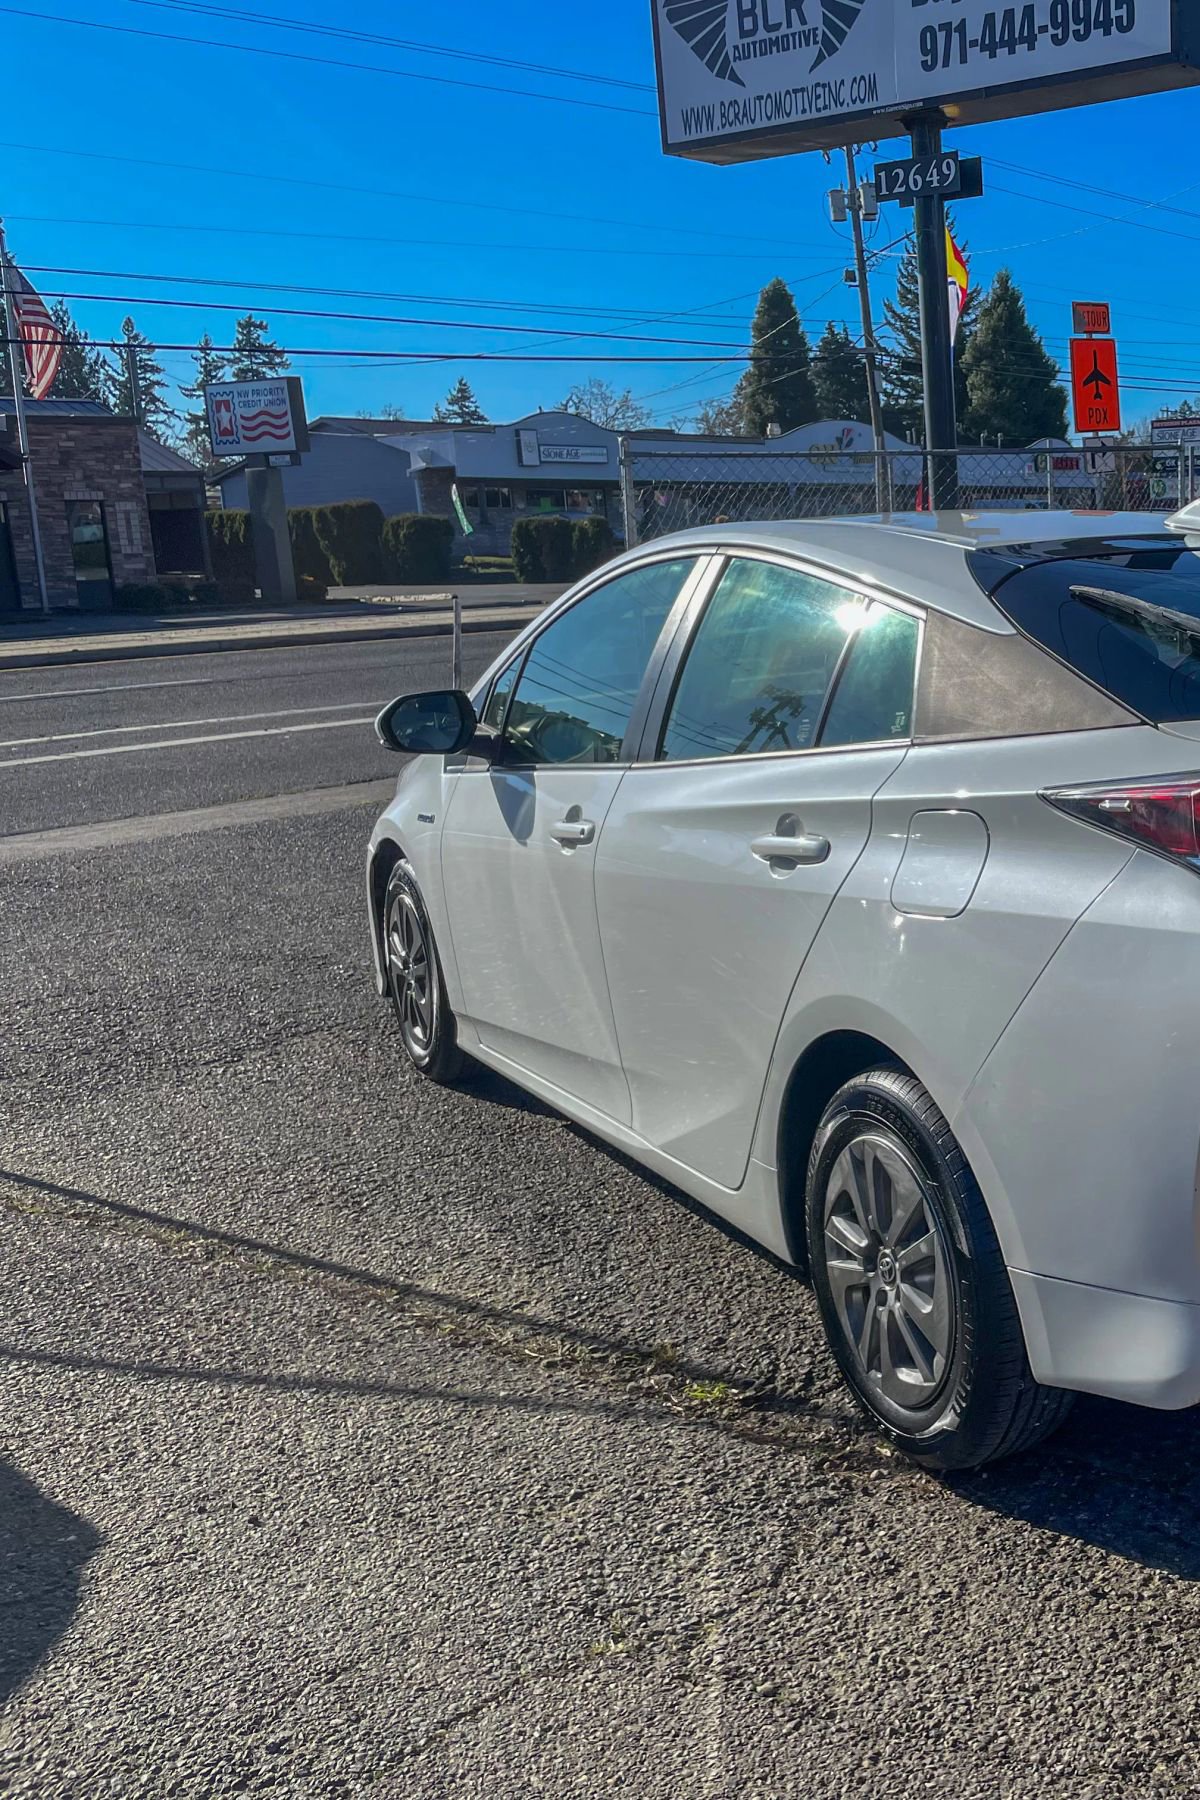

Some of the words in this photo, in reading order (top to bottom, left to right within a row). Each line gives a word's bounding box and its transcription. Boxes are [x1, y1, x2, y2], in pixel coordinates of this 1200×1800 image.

[736, 0, 808, 40] BCR
[919, 0, 1136, 73] 971-444-9945
[733, 27, 820, 63] AUTOMOTIVE
[681, 73, 879, 136] WWW.BCRAUTOMOTIVEINC.COM
[878, 159, 956, 196] 12649
[237, 389, 250, 399] NW
[251, 387, 285, 398] PRIORITY
[238, 400, 261, 408] CREDIT
[263, 398, 287, 408] UNION
[1088, 407, 1108, 425] PDX
